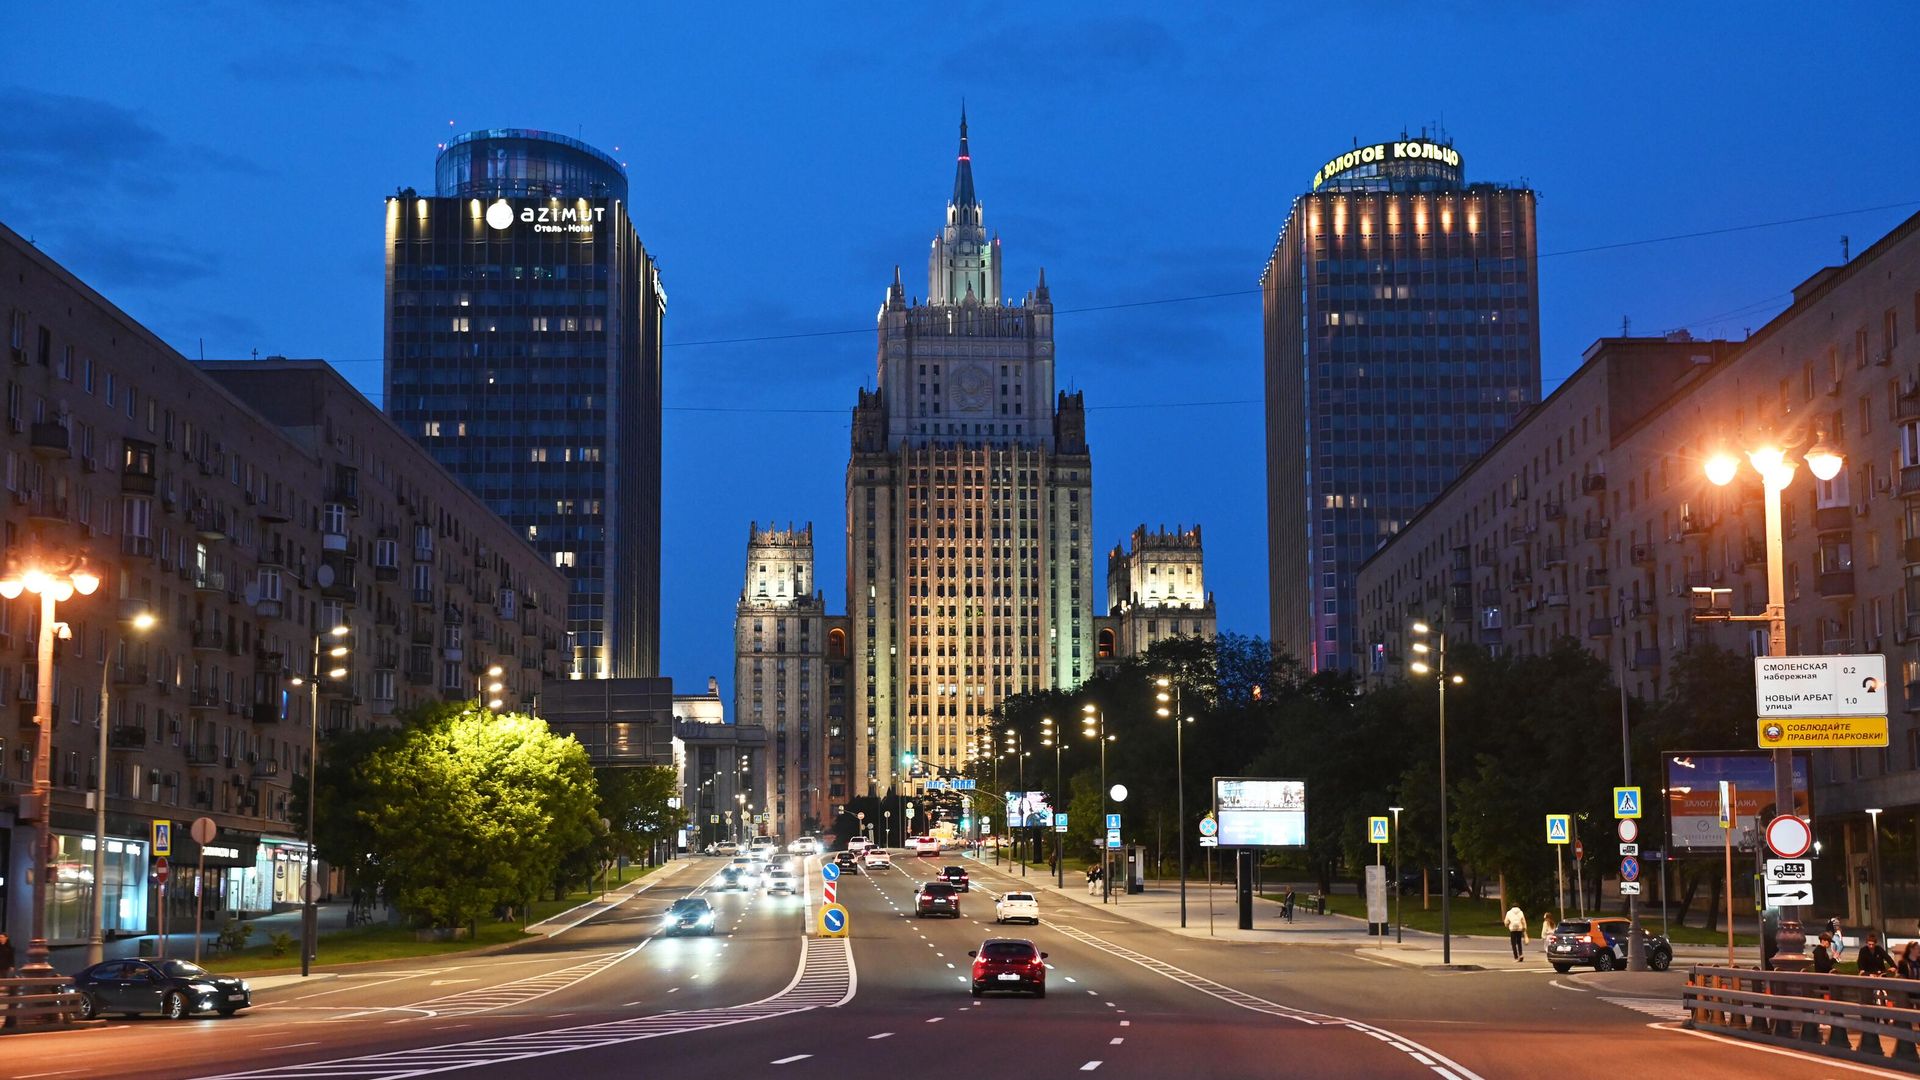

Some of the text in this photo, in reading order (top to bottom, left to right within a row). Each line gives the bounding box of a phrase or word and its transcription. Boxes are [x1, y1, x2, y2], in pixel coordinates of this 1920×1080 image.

[1324, 142, 1459, 179] ЗОЛОТОЕ КОЛЬЦО
[534, 224, 593, 233] Отель Hotel
[1763, 663, 1828, 671] СМОЛЕНСКАЯ
[1764, 673, 1817, 681] набережная
[1765, 693, 1800, 702] НОВЫЙ
[1803, 693, 1833, 701] АРБАТ
[1765, 703, 1792, 711] улица
[1787, 722, 1851, 731] СОБЛЮДАЙТЕ
[1787, 733, 1829, 741] ПРАВИЛА
